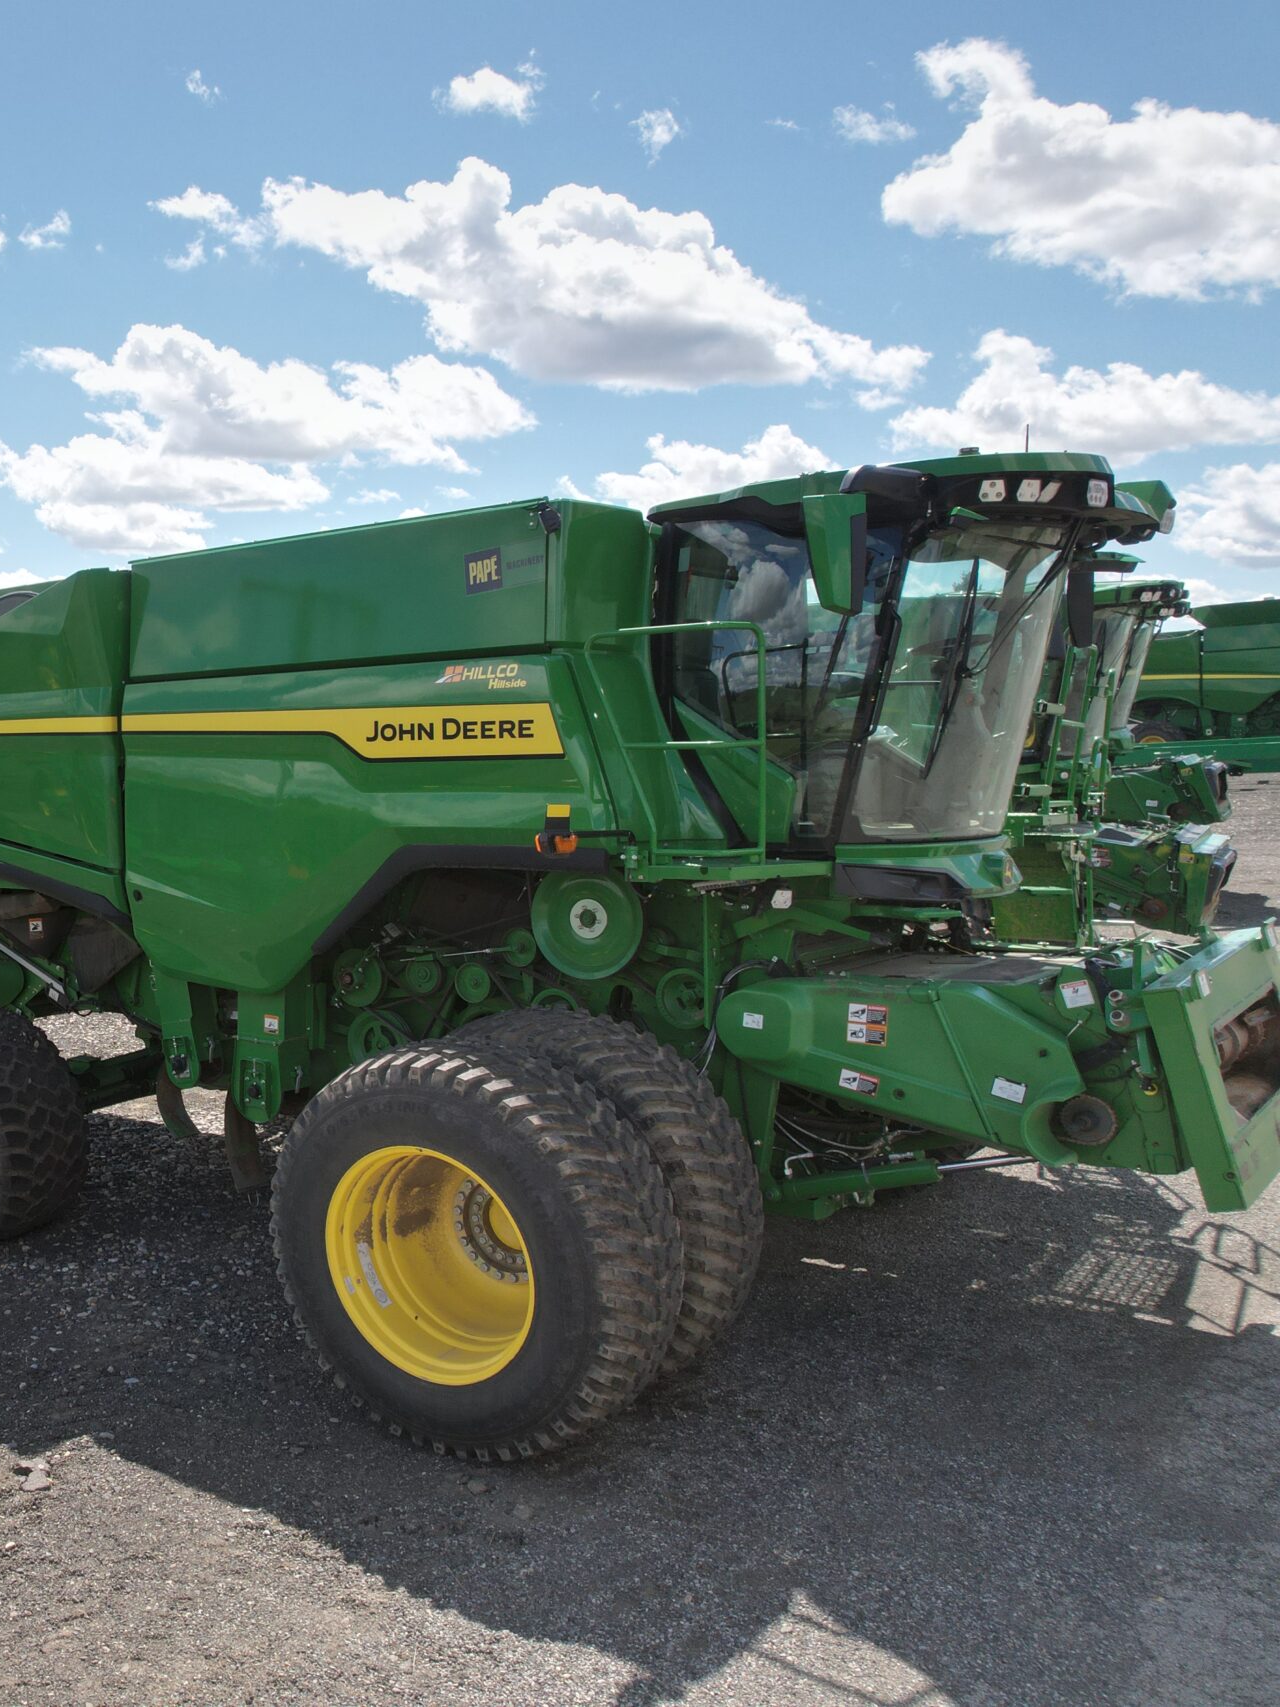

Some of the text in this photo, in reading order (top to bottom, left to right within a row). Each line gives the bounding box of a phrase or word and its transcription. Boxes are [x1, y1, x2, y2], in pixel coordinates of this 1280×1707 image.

[462, 663, 519, 681] HILLCO
[487, 678, 528, 690] Hillside
[366, 718, 535, 743] JOHN DEERE
